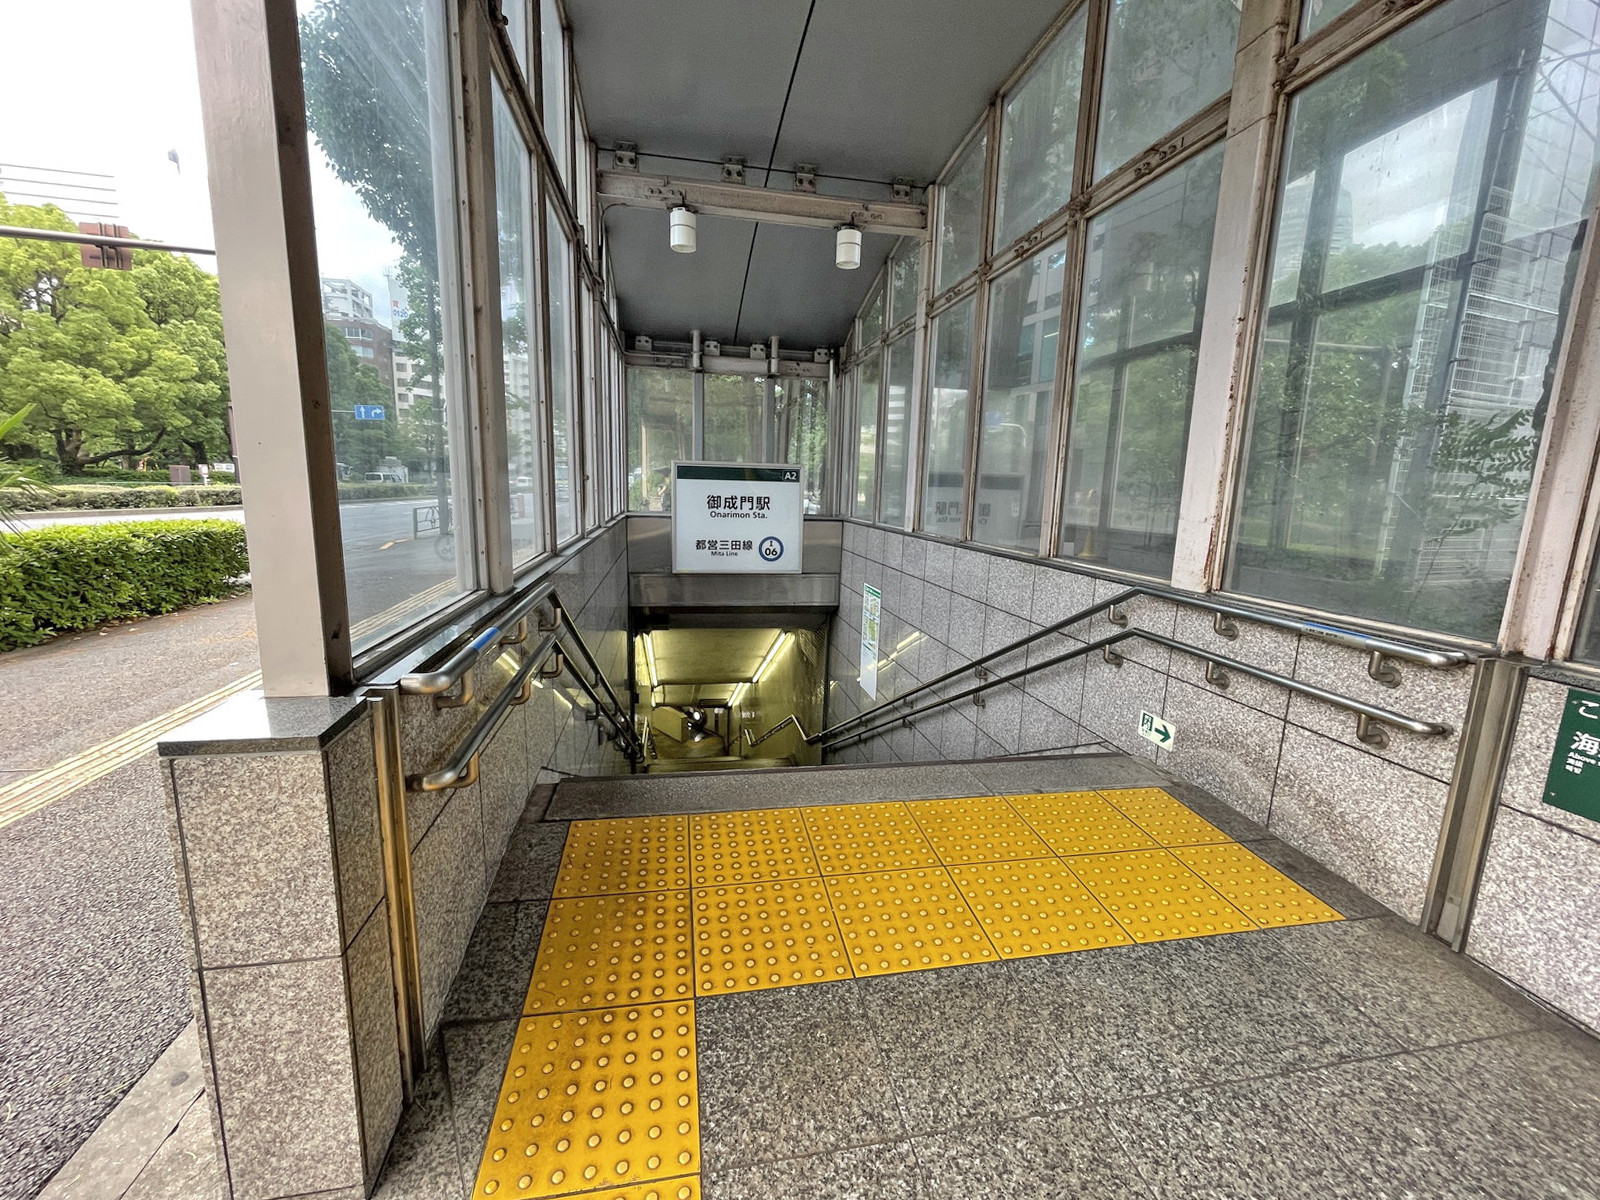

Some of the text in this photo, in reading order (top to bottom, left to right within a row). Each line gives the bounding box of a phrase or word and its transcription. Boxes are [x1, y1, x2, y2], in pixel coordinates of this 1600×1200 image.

[784, 471, 797, 480] A2
[706, 494, 770, 510] 御成門駅
[709, 511, 750, 519] Onarimon
[695, 539, 753, 551] 都営三田線
[764, 547, 778, 556] 06
[1571, 731, 1600, 757] 海
[1567, 751, 1597, 765] Above
